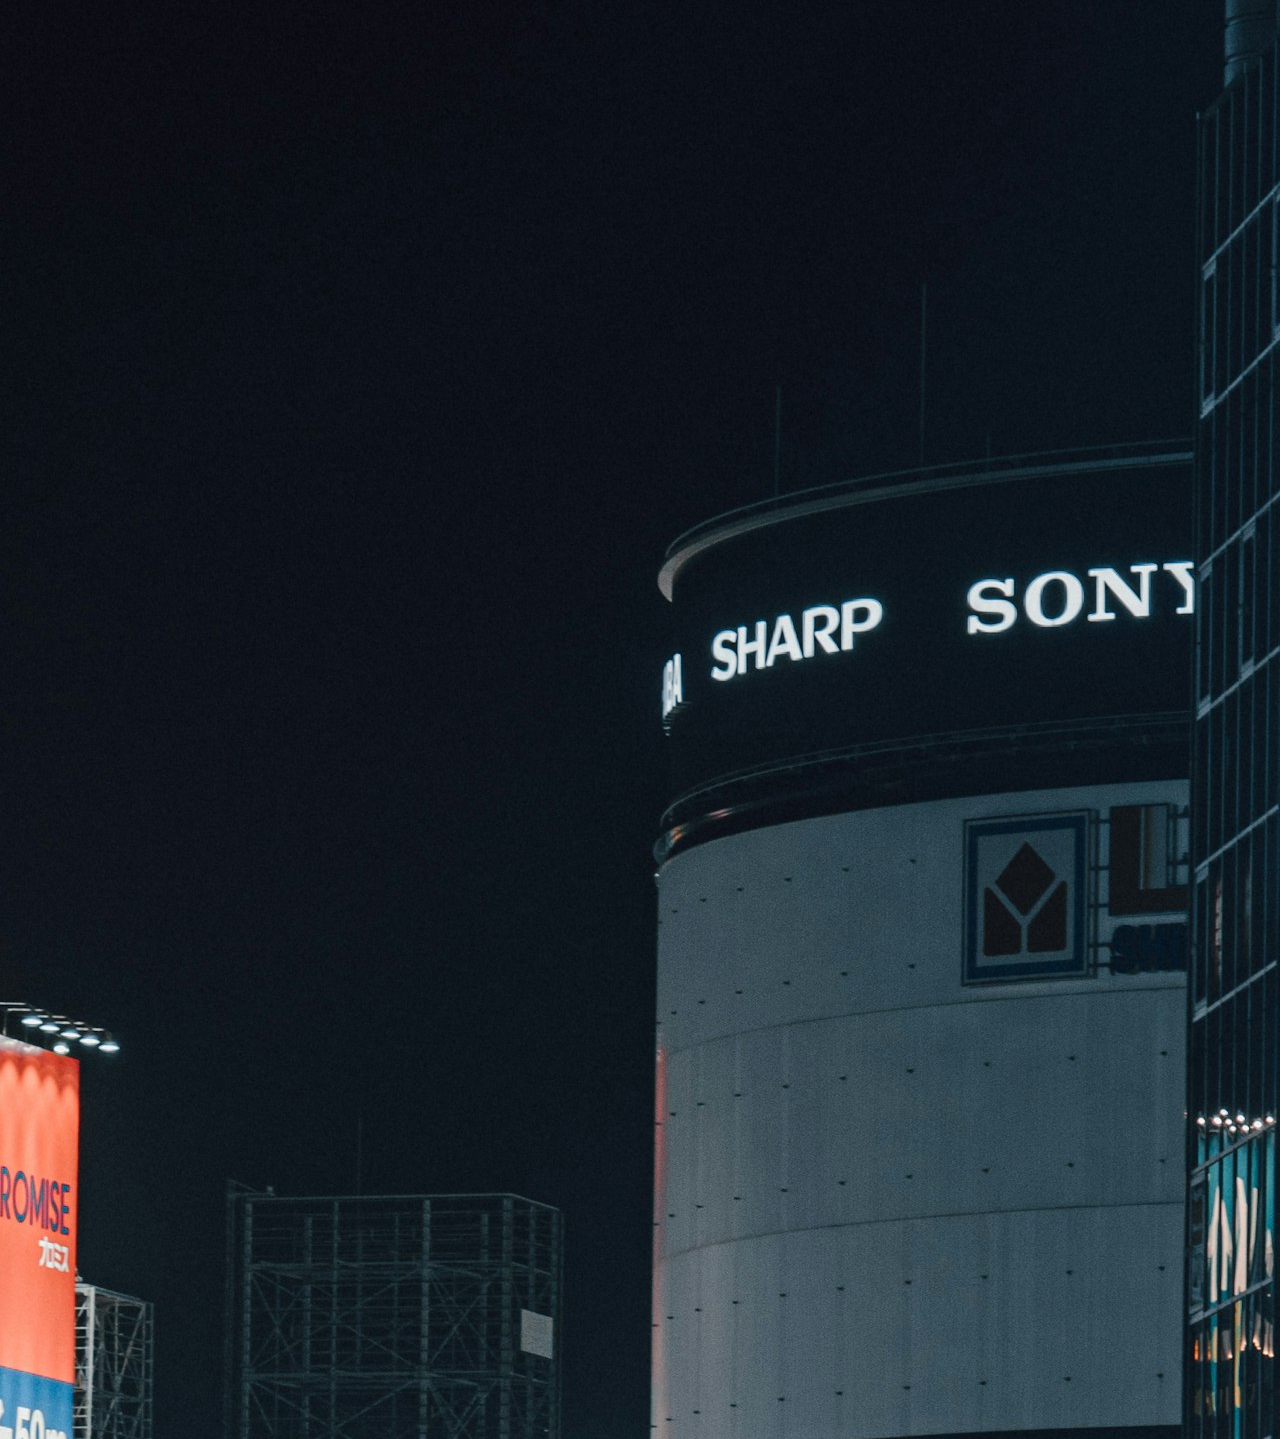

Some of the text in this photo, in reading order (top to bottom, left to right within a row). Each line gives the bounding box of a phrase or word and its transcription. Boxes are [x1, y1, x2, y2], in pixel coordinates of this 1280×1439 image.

[710, 597, 884, 683] SHARP
[38, 1235, 70, 1273] プロミス
